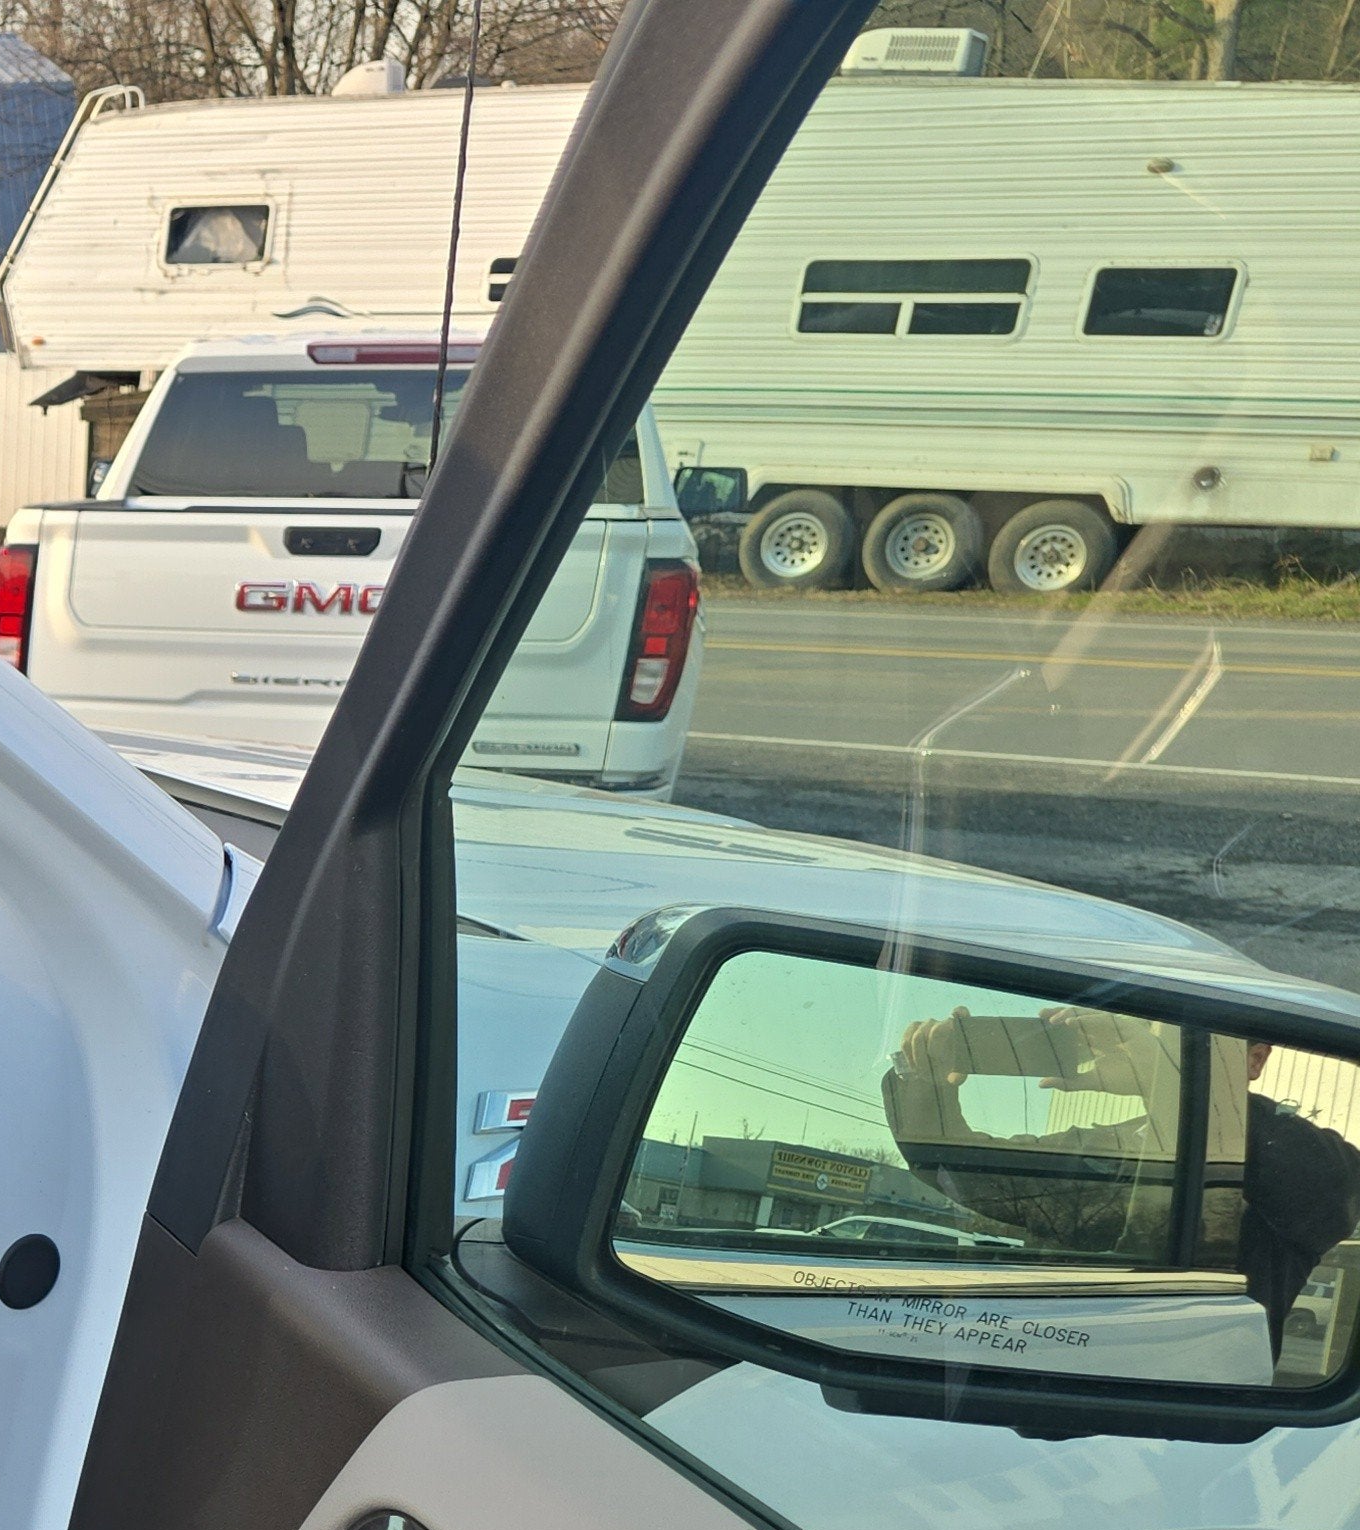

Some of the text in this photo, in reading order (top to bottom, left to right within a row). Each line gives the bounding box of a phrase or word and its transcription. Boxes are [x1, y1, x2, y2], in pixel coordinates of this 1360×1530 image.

[793, 1271, 866, 1295] OBJECTS
[901, 1296, 967, 1319] MIRROR
[977, 1312, 1012, 1330] ARE
[1022, 1321, 1090, 1347] CLOSER
[847, 1301, 893, 1323] THAN
[903, 1313, 948, 1336] THEY
[954, 1327, 1027, 1354] APPEAR
